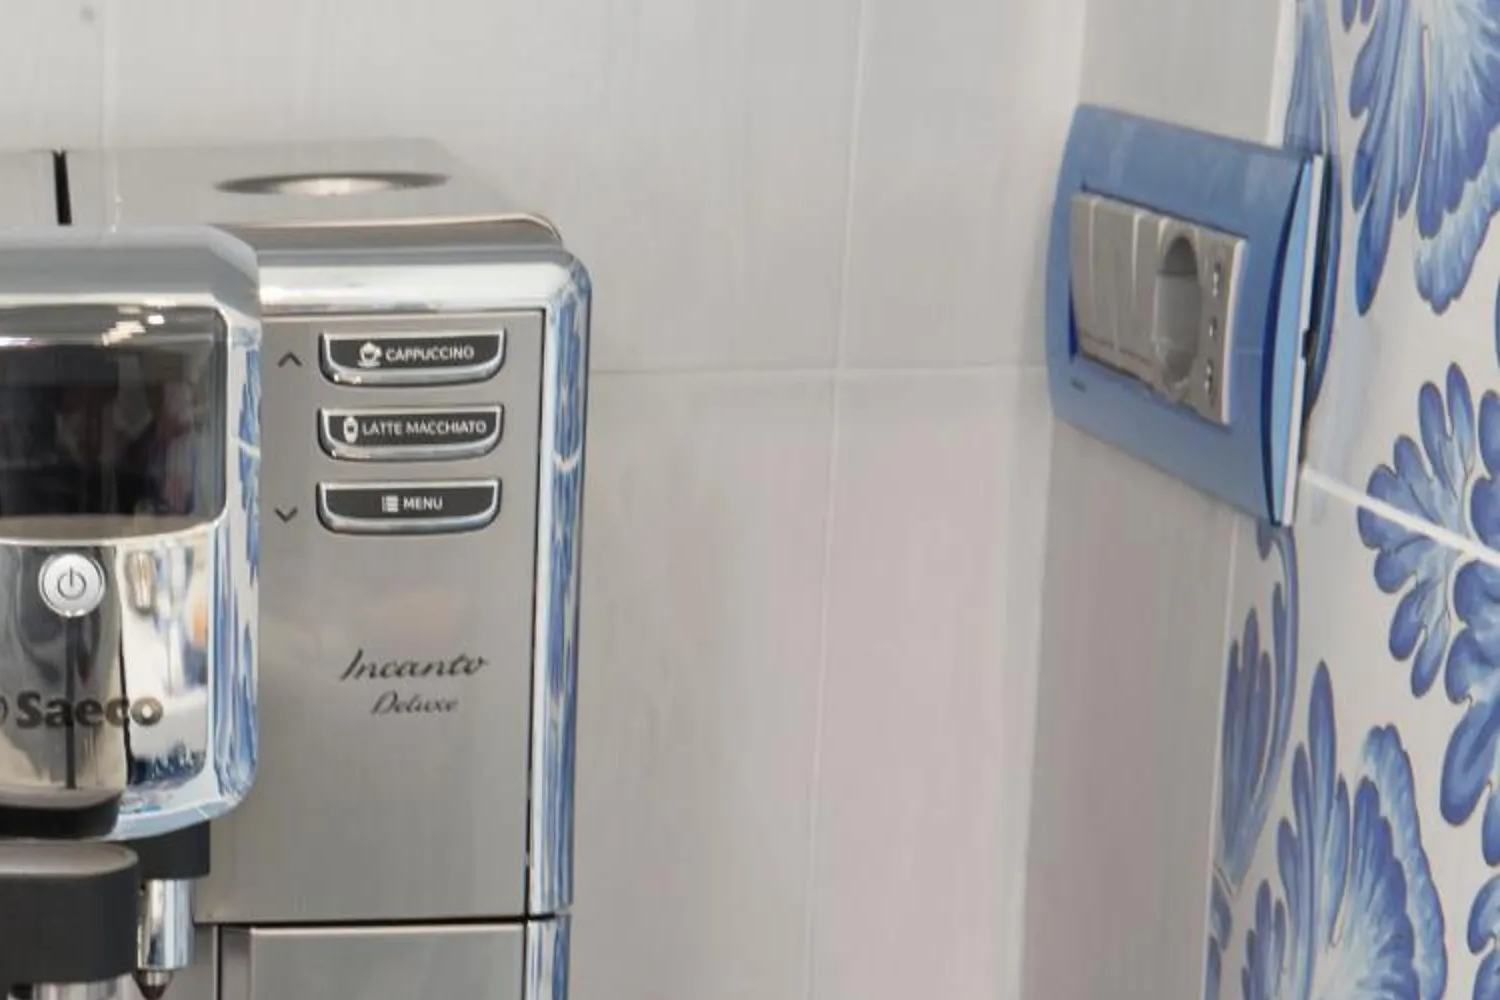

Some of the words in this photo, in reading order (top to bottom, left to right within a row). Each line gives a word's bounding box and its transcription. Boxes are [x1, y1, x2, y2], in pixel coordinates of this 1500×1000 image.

[385, 344, 475, 363] CAPPUCCINO
[362, 422, 402, 437] LATTE
[406, 421, 487, 437] MACCHIATO
[403, 495, 444, 511] MENU
[340, 648, 489, 682] Incanto
[16, 690, 164, 729] Saeco
[370, 688, 459, 716] Deluxe
